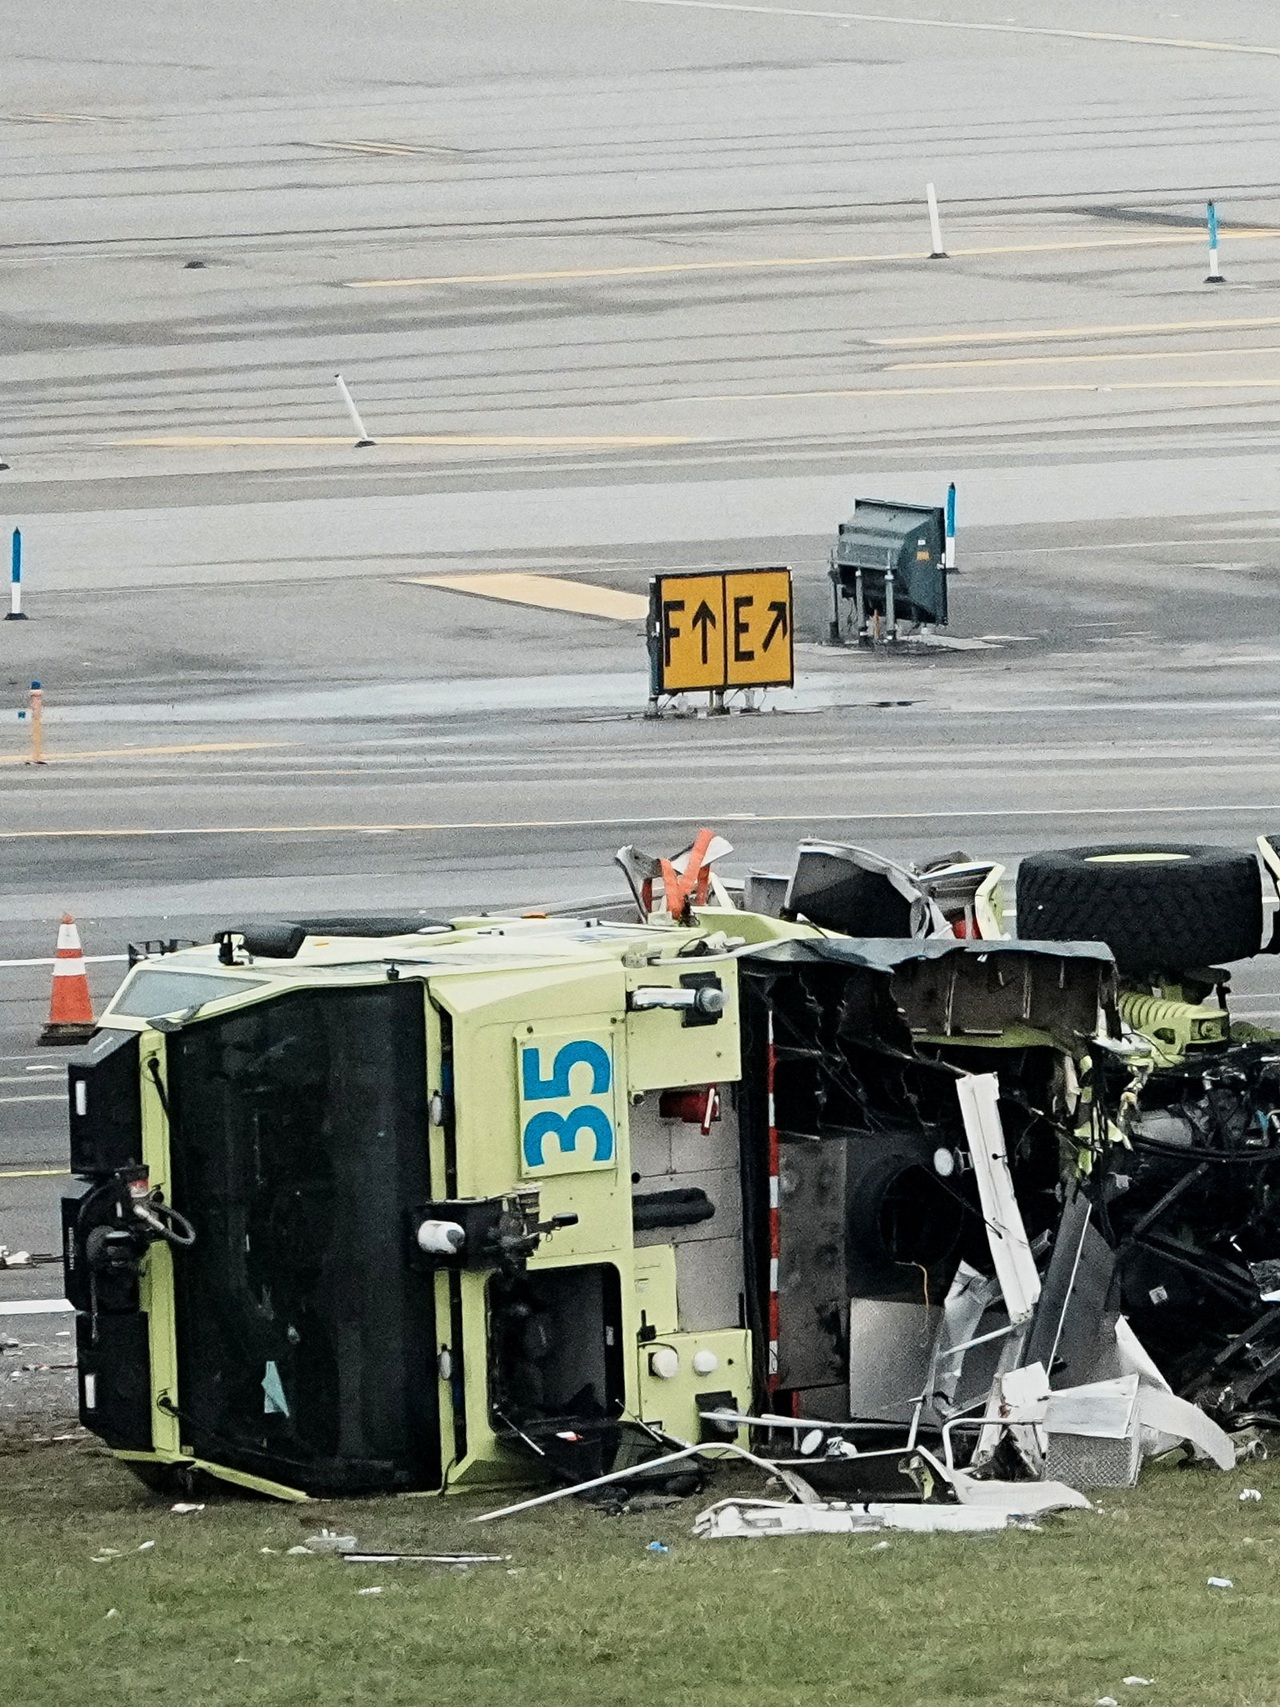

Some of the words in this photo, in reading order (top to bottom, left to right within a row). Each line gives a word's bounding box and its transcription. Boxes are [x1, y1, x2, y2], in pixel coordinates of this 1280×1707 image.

[664, 600, 685, 667] F
[734, 596, 755, 661] E
[522, 1040, 613, 1167] 35
